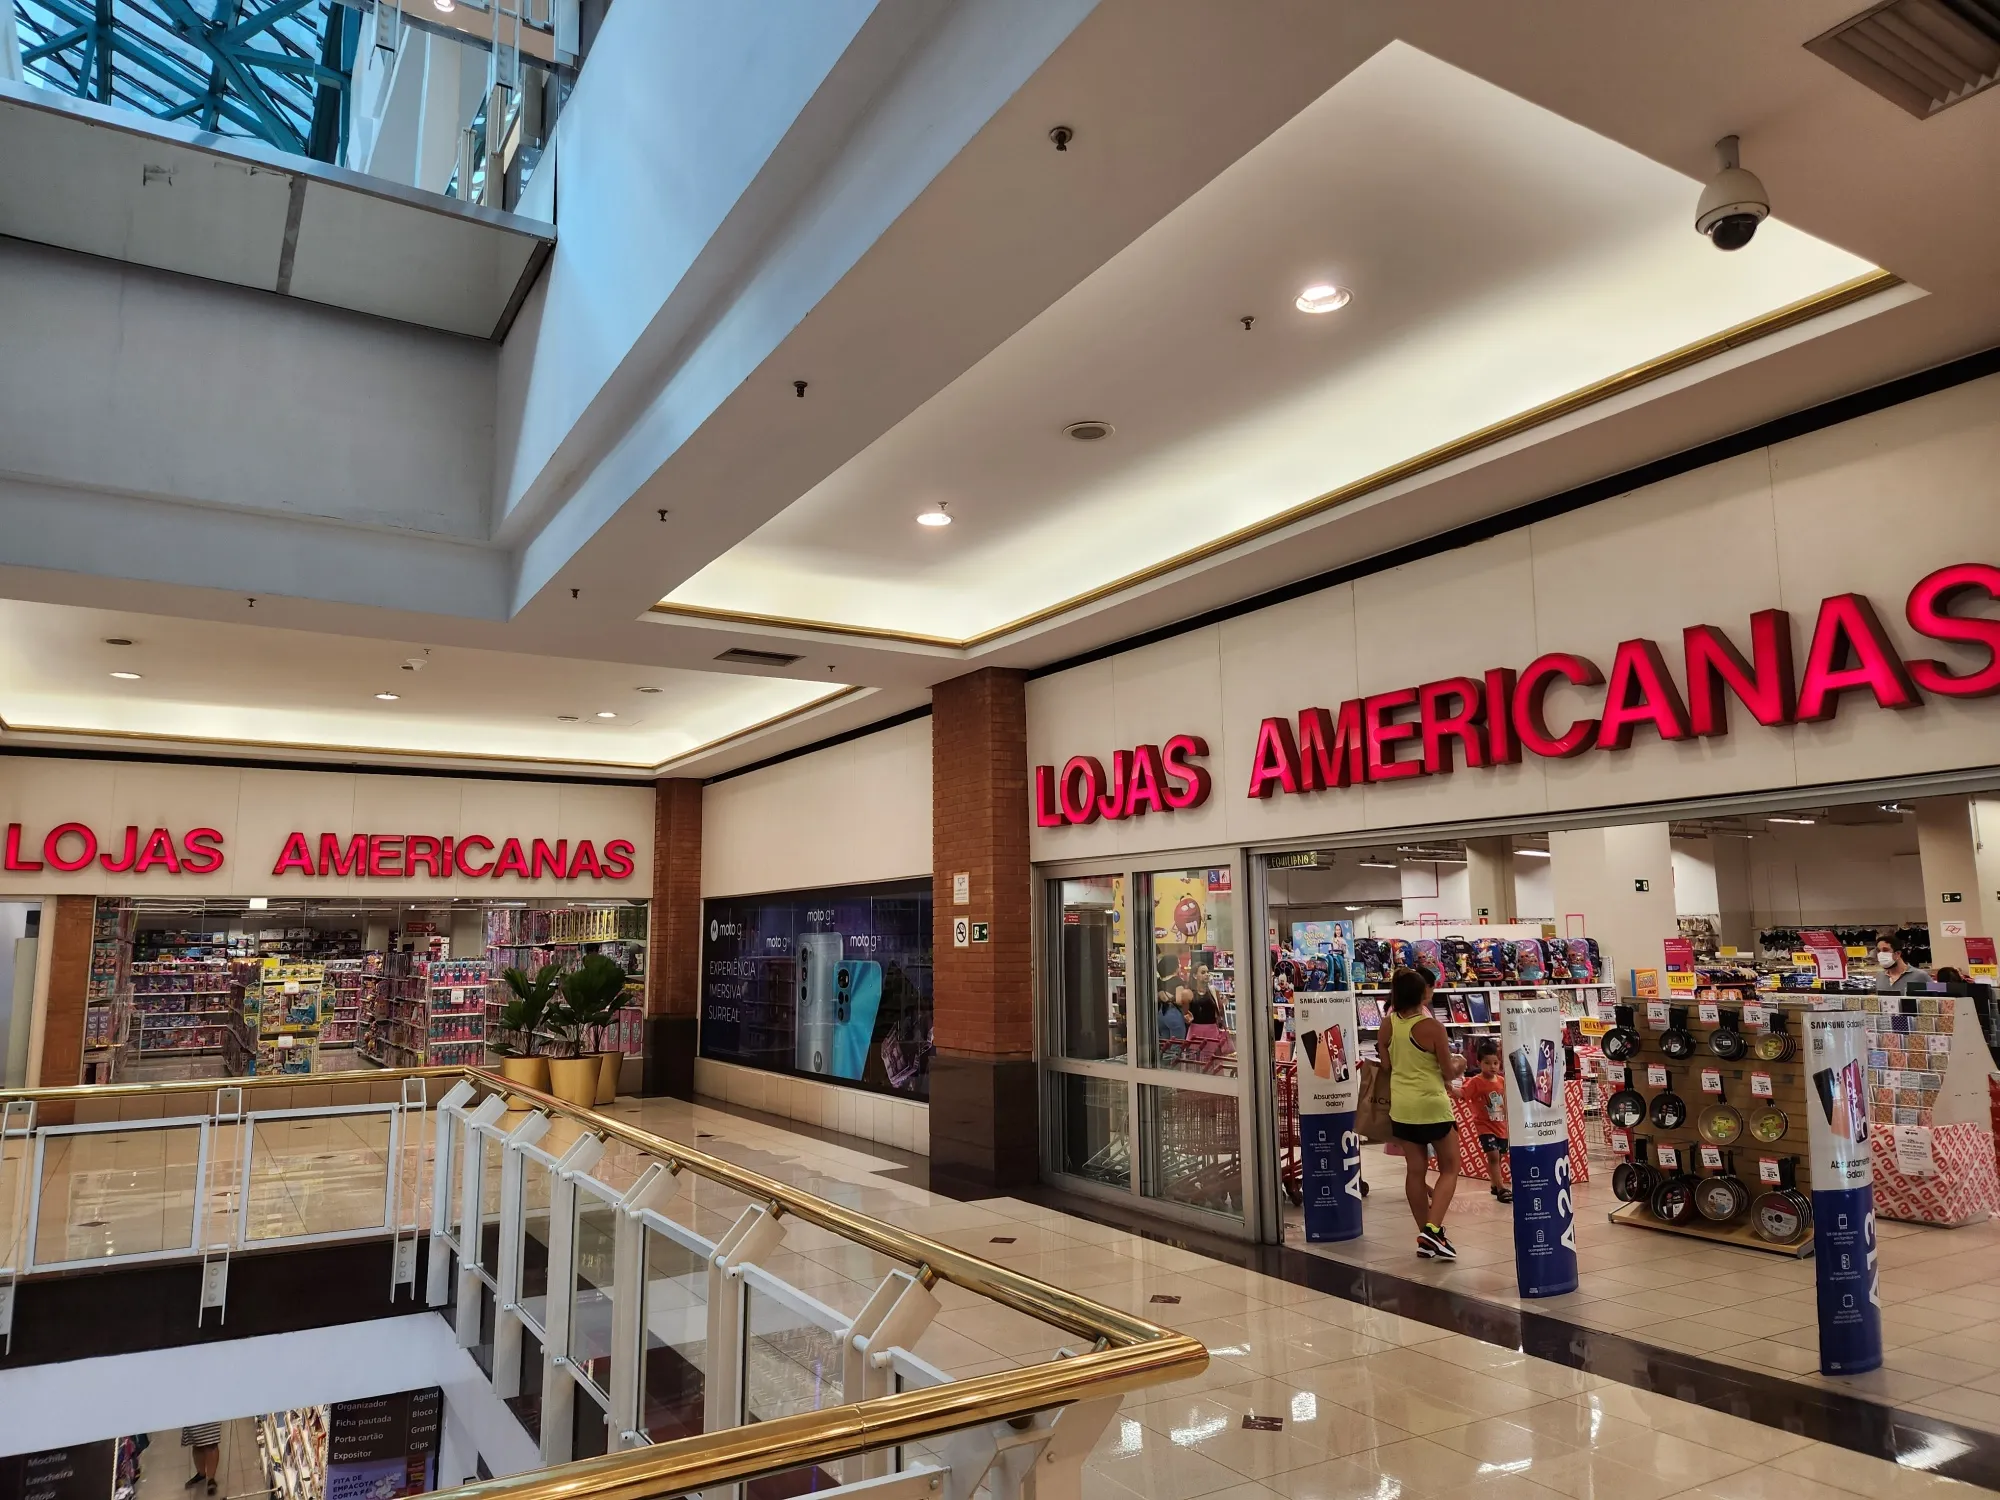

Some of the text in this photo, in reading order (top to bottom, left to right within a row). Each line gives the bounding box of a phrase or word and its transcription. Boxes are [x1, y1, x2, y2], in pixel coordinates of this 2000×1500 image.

[1036, 562, 2000, 829] LOJAS AMERICANAS
[4, 822, 636, 880] LOJAS AMERICANAS
[806, 909, 824, 921] moto
[719, 921, 736, 936] moto
[766, 935, 782, 948] moto
[850, 933, 870, 947] moto
[709, 958, 756, 976] EXPERIÊNCIA
[709, 983, 742, 999] IMERSIVA
[708, 1004, 741, 1023] SURREAL
[1506, 1007, 1537, 1015] SAMSUNG
[1810, 1020, 1845, 1029] SAMSUNG
[1537, 1129, 1557, 1137] Galaxy
[1341, 1130, 1362, 1200] A13
[1846, 1170, 1866, 1179] Galaxy
[1554, 1154, 1577, 1253] A23
[337, 1400, 388, 1412] Organizador
[412, 1410, 433, 1418] Bloco
[336, 1416, 392, 1427] Ficha pautada
[411, 1424, 437, 1434] Gramp
[358, 1433, 384, 1442] cartão
[410, 1441, 429, 1450] Clips
[27, 1452, 68, 1467] Mochila
[333, 1451, 372, 1461] Expositor
[25, 1469, 74, 1487] Lancheira
[333, 1474, 363, 1485] FITA DE
[332, 1491, 359, 1500] CORTA
